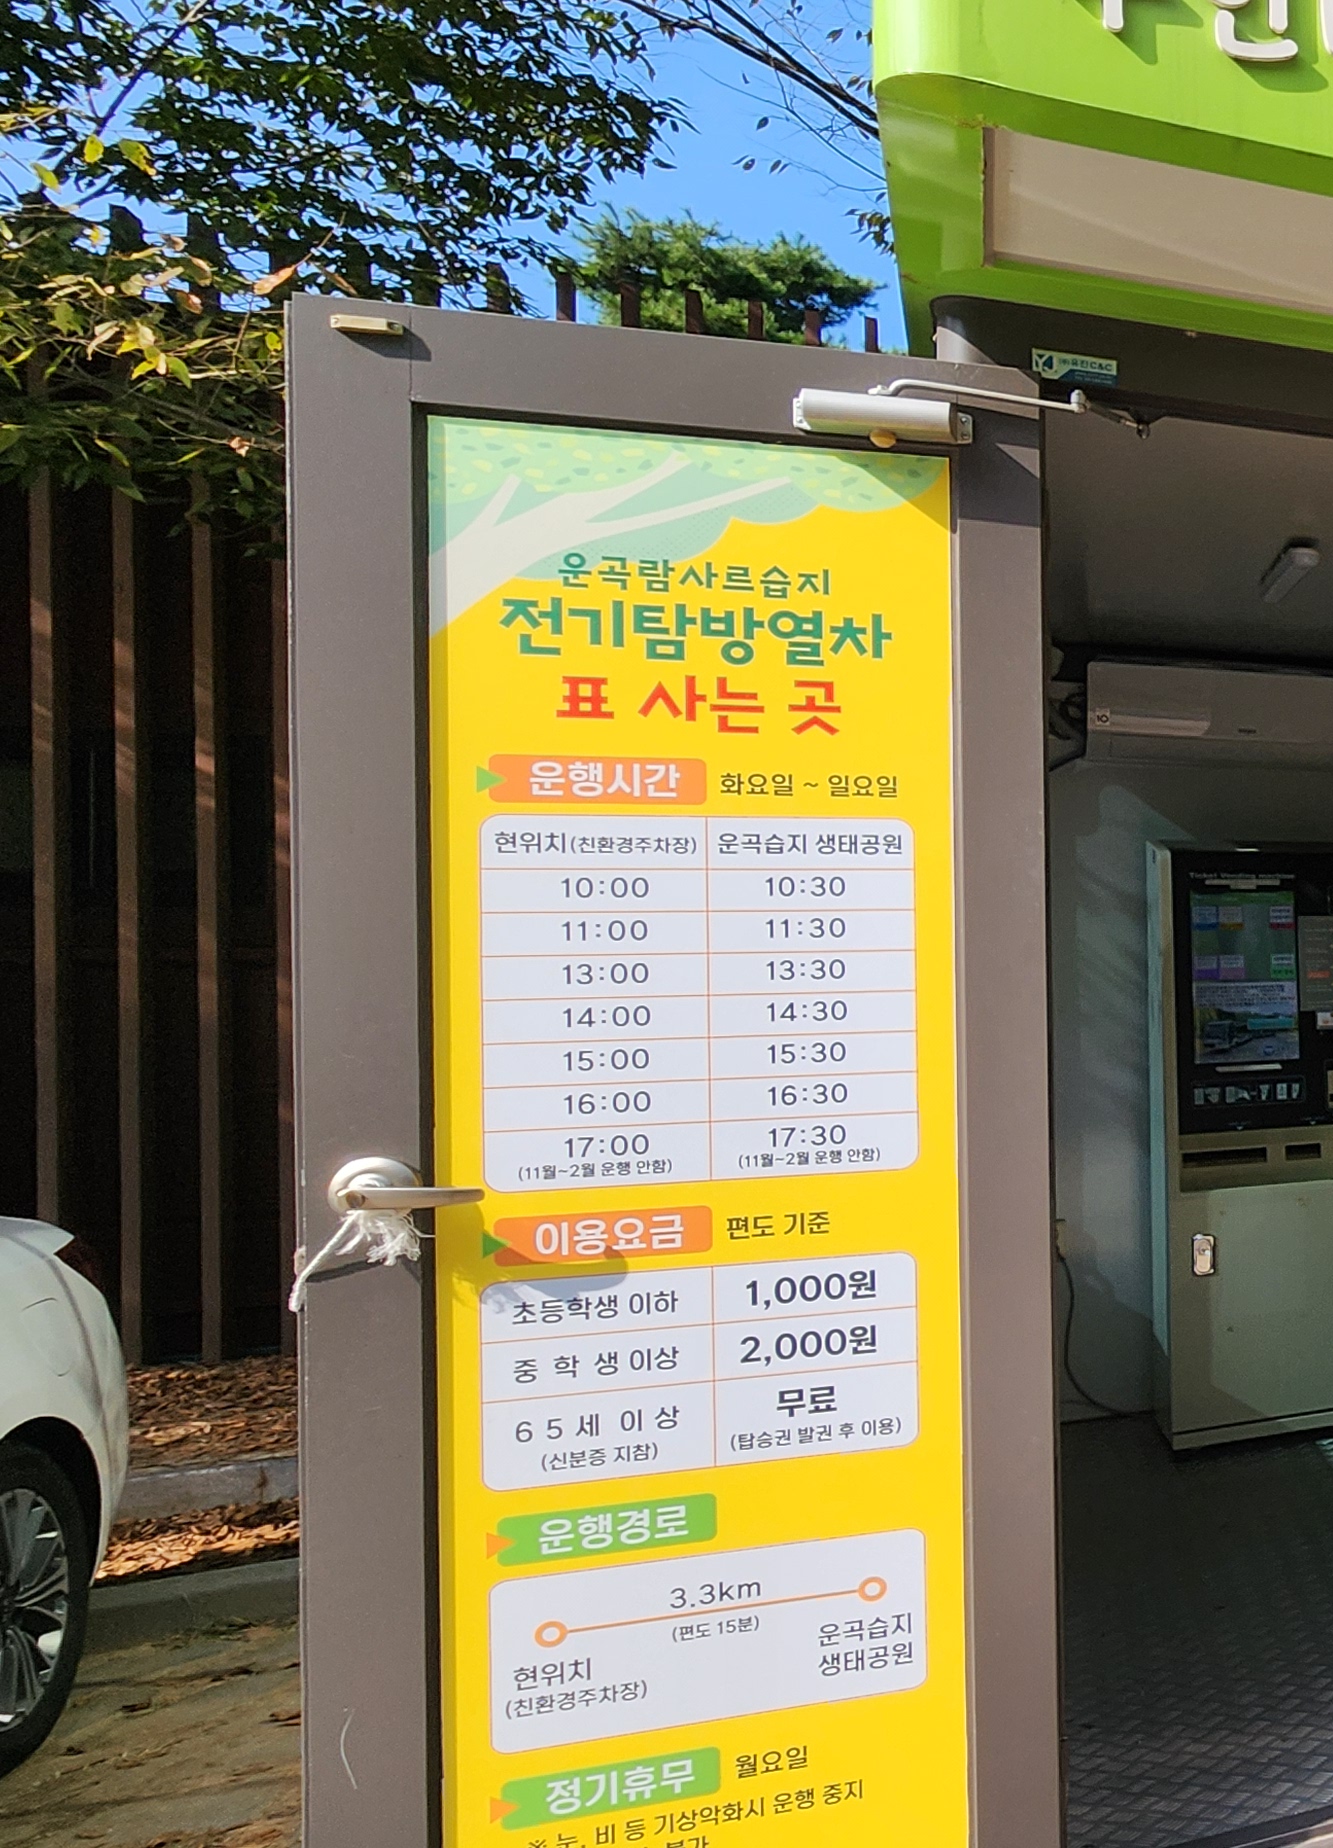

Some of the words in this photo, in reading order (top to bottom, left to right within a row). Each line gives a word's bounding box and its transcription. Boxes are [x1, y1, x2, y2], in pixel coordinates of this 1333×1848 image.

[558, 552, 830, 597] 운곡람사르습지
[500, 597, 892, 666] 전기탐방열차
[556, 676, 614, 720] 표
[638, 675, 765, 735] 사는
[788, 680, 842, 735] 곳
[529, 760, 680, 798] 운행시간
[720, 773, 794, 797] 화요일
[829, 775, 898, 798] 일요일
[494, 832, 698, 855] 현위치(친환경주차장)
[717, 834, 808, 855] 운곡습지
[816, 834, 903, 854] 생태공원
[561, 876, 650, 899] 10:00
[764, 876, 846, 897] 10:30
[561, 920, 649, 942] 11:00
[765, 917, 846, 939] 11:30
[562, 962, 649, 984] 13:00
[766, 958, 846, 980] 13:30
[563, 1005, 651, 1028] 14:00
[766, 1000, 847, 1022] 14:30
[563, 1048, 650, 1071] 15:00
[767, 1041, 847, 1064] 15:30
[563, 1091, 652, 1114] 16:00
[767, 1083, 848, 1106] 16:30
[564, 1134, 650, 1158] 17:00
[768, 1124, 847, 1147] 17:30
[518, 1163, 596, 1181] (11월~2월
[600, 1161, 632, 1177] 운행
[636, 1158, 673, 1176] 안함)
[738, 1151, 810, 1170] (11월~2월
[814, 1149, 843, 1165] 운행
[846, 1147, 881, 1164] 안함)
[535, 1214, 685, 1256] 이용요금
[726, 1215, 775, 1241] 편도
[783, 1212, 831, 1236] 기준
[746, 1269, 878, 1309] 1,000원
[512, 1294, 620, 1326] 초등학생
[628, 1290, 679, 1316] 이하
[740, 1324, 878, 1364] 2,000원
[629, 1346, 679, 1372] 이상
[776, 1386, 837, 1418] 무료
[730, 1429, 792, 1452] (탑승권
[798, 1426, 832, 1445] 발권
[838, 1421, 855, 1439] 후
[860, 1417, 902, 1438] 이용)
[541, 1451, 607, 1472] (신분증
[613, 1442, 659, 1463] 지참)
[539, 1504, 689, 1555] 운행경로
[670, 1581, 761, 1609] 3.3km
[672, 1621, 711, 1642] (편도
[717, 1616, 760, 1636] 15분)
[818, 1613, 913, 1647] 운곡습지
[818, 1641, 914, 1676] 생태공원
[513, 1658, 592, 1691] 현위치
[506, 1680, 647, 1719] (친환경주차장)
[735, 1746, 808, 1778] 월요일
[545, 1759, 695, 1814] 정기휴무
[596, 1824, 616, 1845] 비
[624, 1819, 646, 1840] 등
[654, 1798, 765, 1835] 기상악화시
[773, 1788, 815, 1811] 운행
[822, 1779, 863, 1804] 중지
